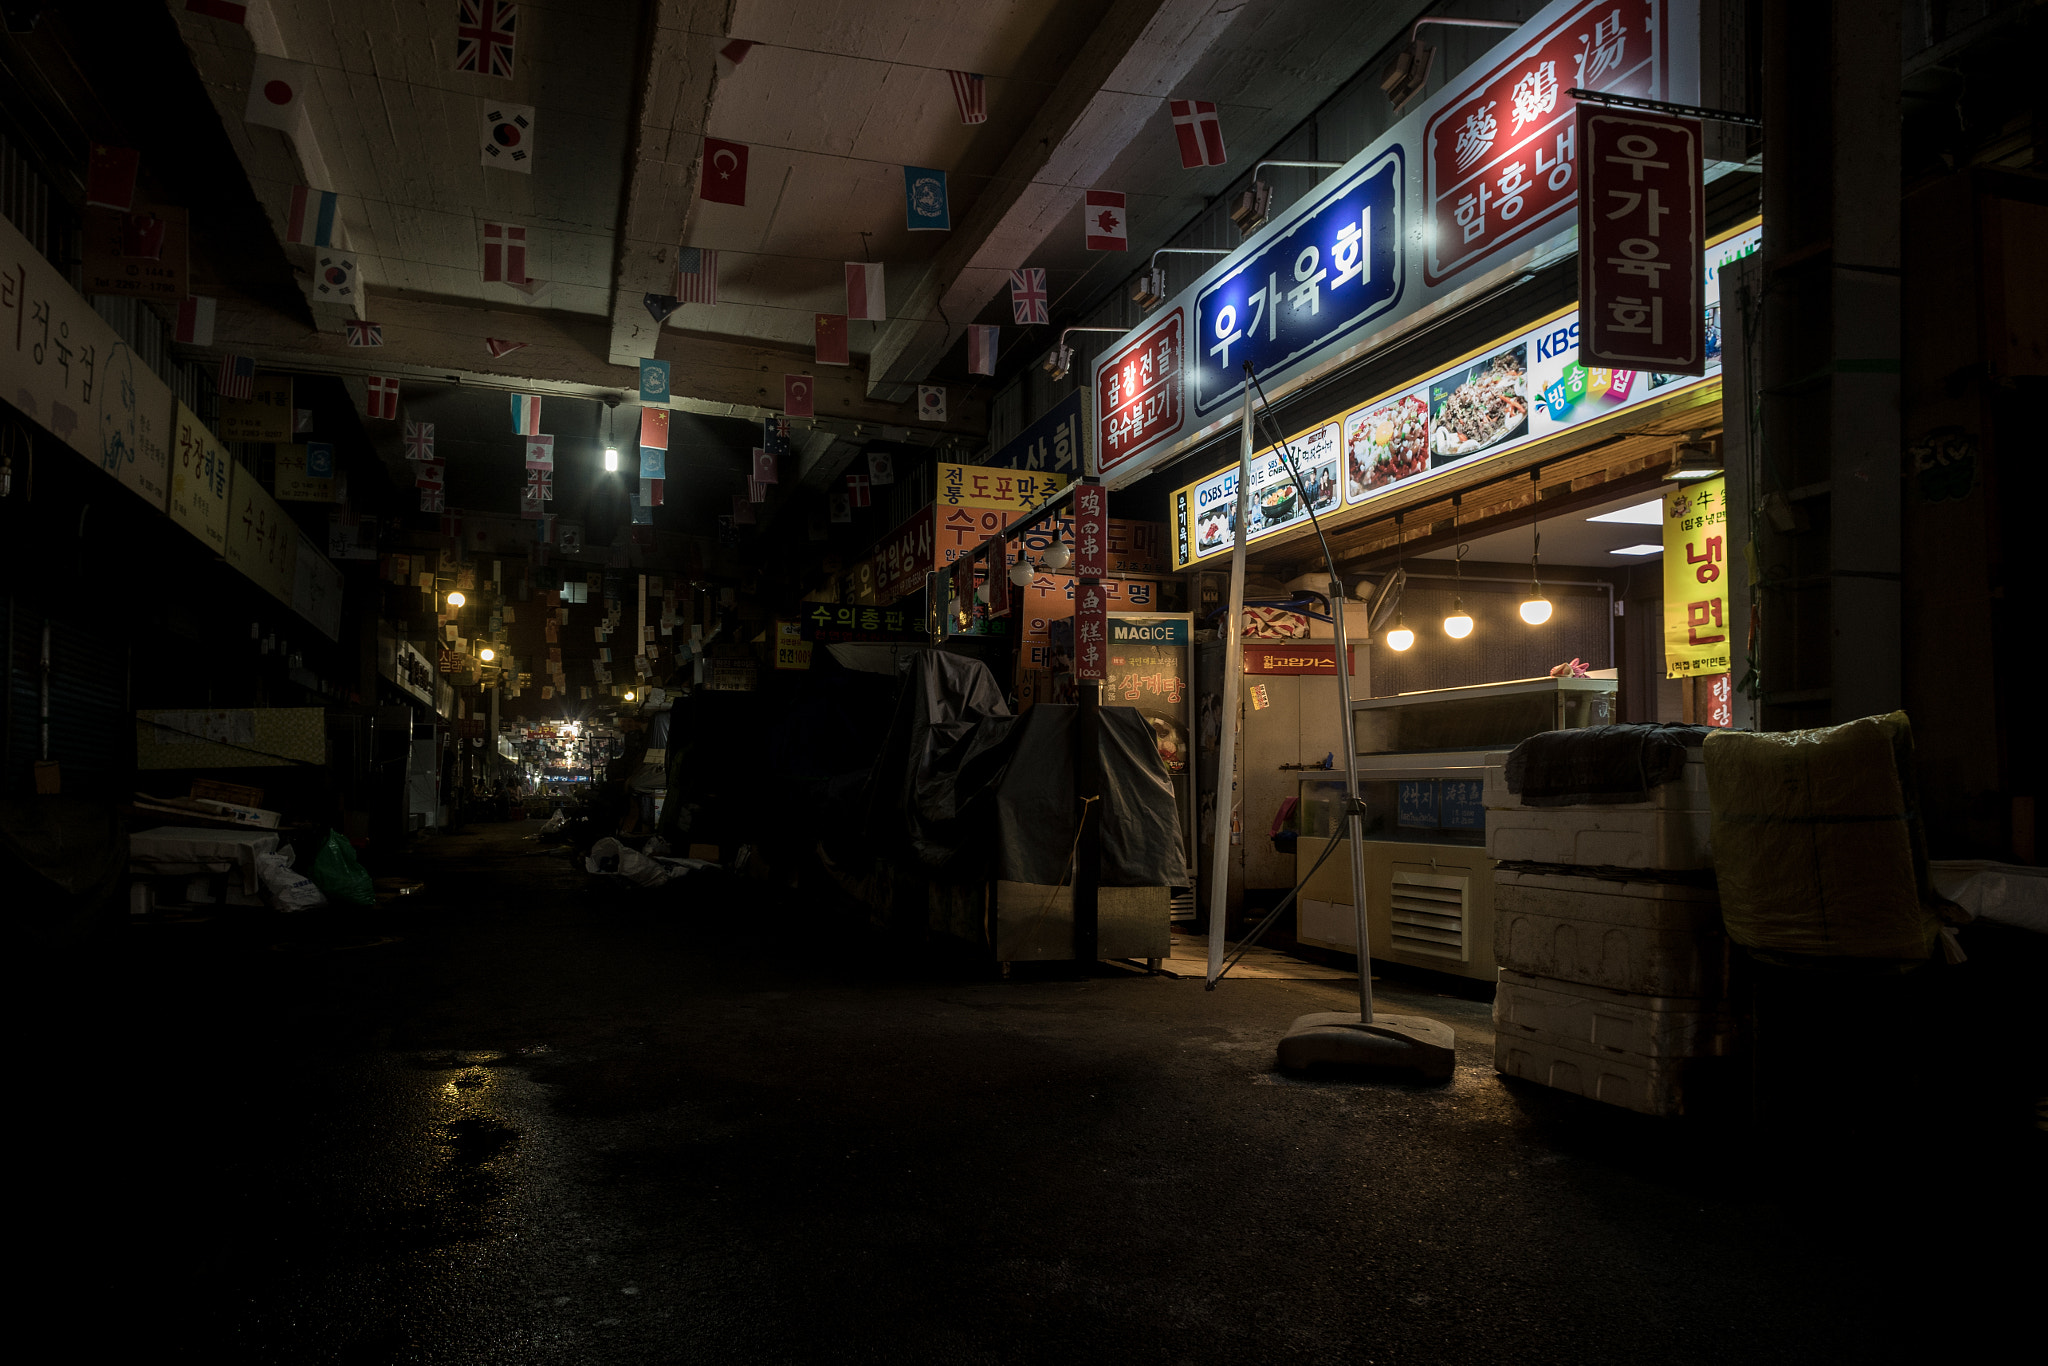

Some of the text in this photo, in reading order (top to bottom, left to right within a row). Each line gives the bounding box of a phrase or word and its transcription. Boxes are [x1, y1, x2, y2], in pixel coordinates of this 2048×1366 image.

[1605, 134, 1671, 345] 우가육회
[1209, 205, 1372, 369] 우가육회
[32, 300, 95, 404] 정육점
[1108, 336, 1171, 408] 곱창전골
[1107, 383, 1172, 450] 육수불고기
[1207, 484, 1223, 503] SBS
[876, 520, 932, 589] 경원상사
[1078, 563, 1103, 576] 3000
[1685, 535, 1726, 646] 냉면
[811, 605, 906, 633] 수의총판
[1114, 626, 1175, 640] MAGICE
[1078, 668, 1101, 678] 1000
[1273, 657, 1336, 668] 고압가스
[1118, 673, 1186, 703] 삼계탕
